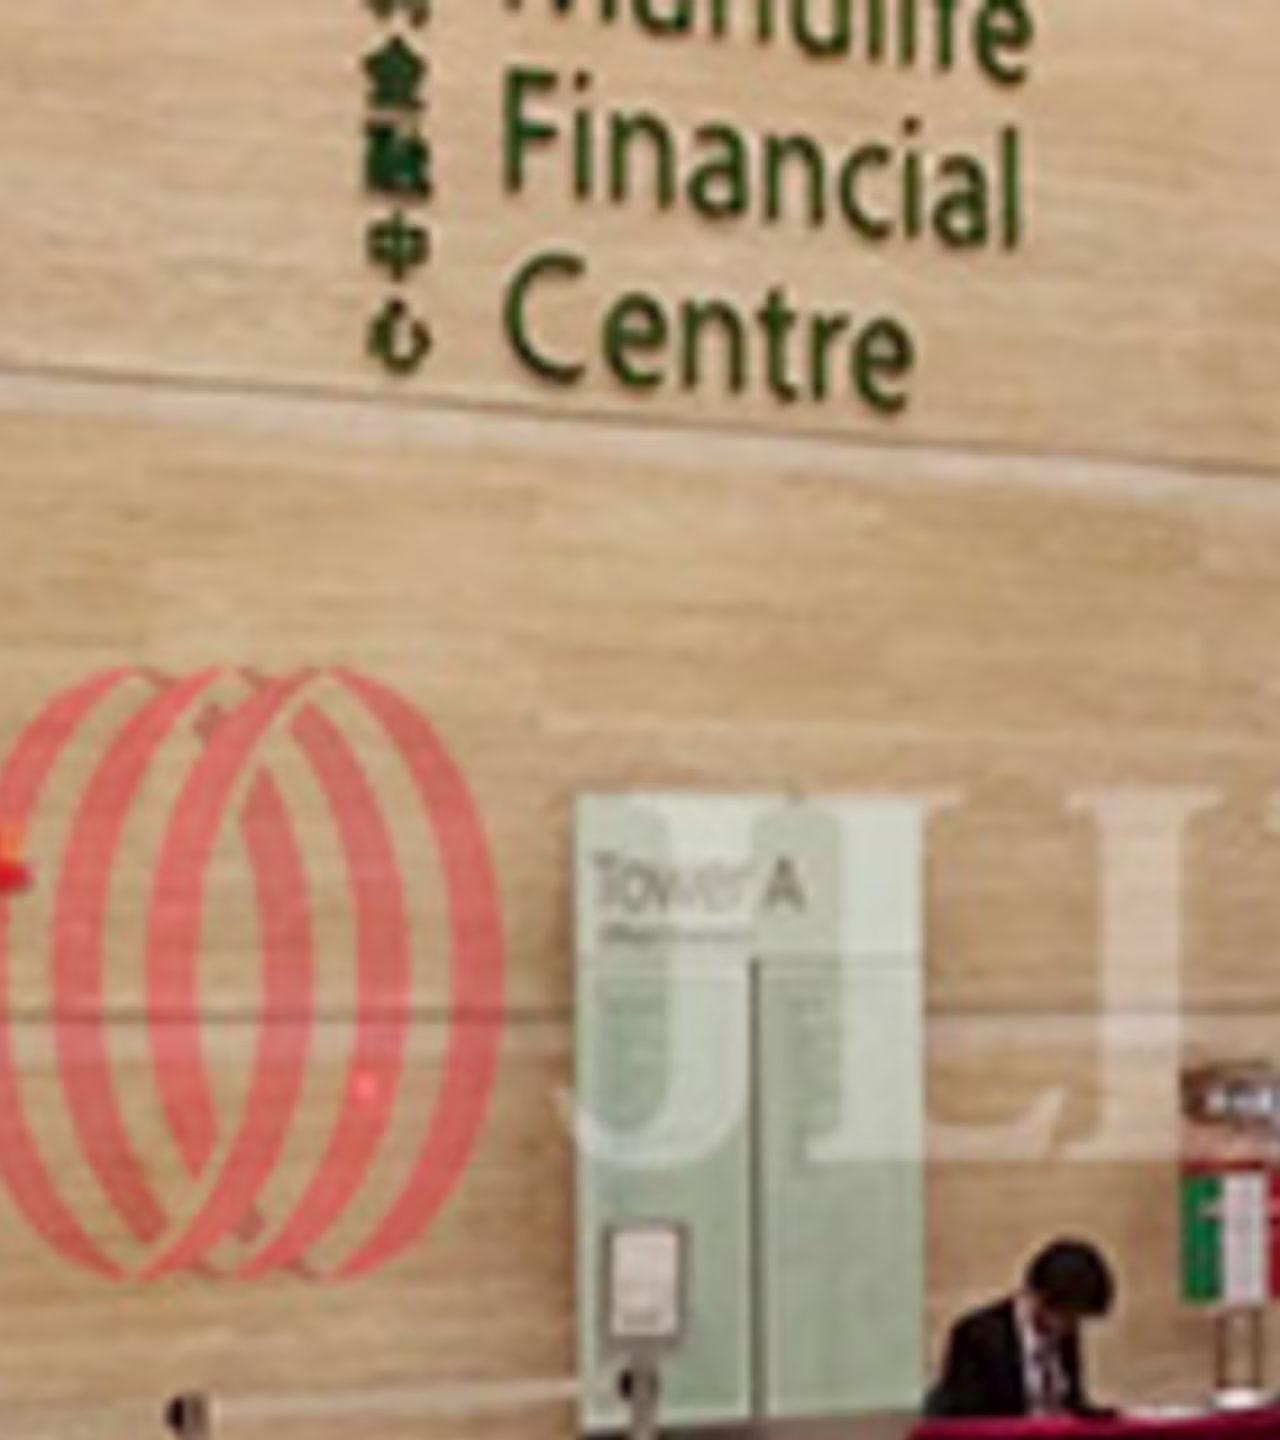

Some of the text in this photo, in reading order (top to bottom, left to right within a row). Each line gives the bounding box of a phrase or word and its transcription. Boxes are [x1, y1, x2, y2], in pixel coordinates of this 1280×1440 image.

[504, 63, 1020, 253] Financial
[502, 251, 914, 414] Centre
[592, 850, 807, 916] Tower A
